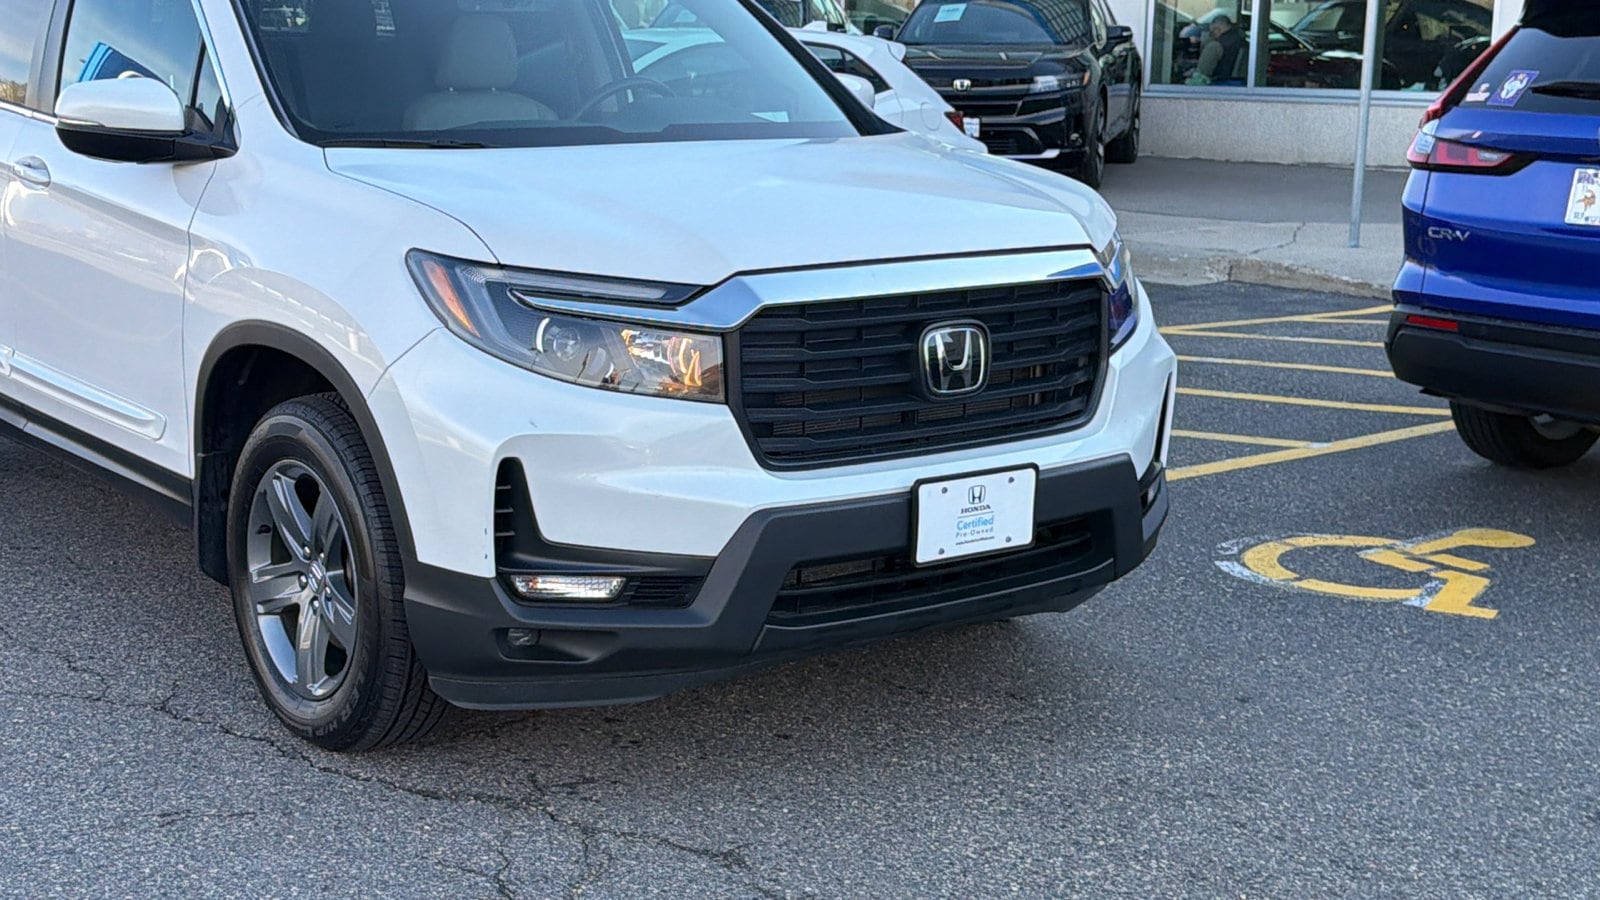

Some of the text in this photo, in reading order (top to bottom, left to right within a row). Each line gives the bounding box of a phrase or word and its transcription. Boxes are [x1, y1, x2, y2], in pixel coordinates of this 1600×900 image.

[1427, 226, 1471, 241] CR-V
[960, 504, 991, 514] HONDA
[957, 515, 995, 531] Certified
[955, 526, 994, 538] Pre-Owned
